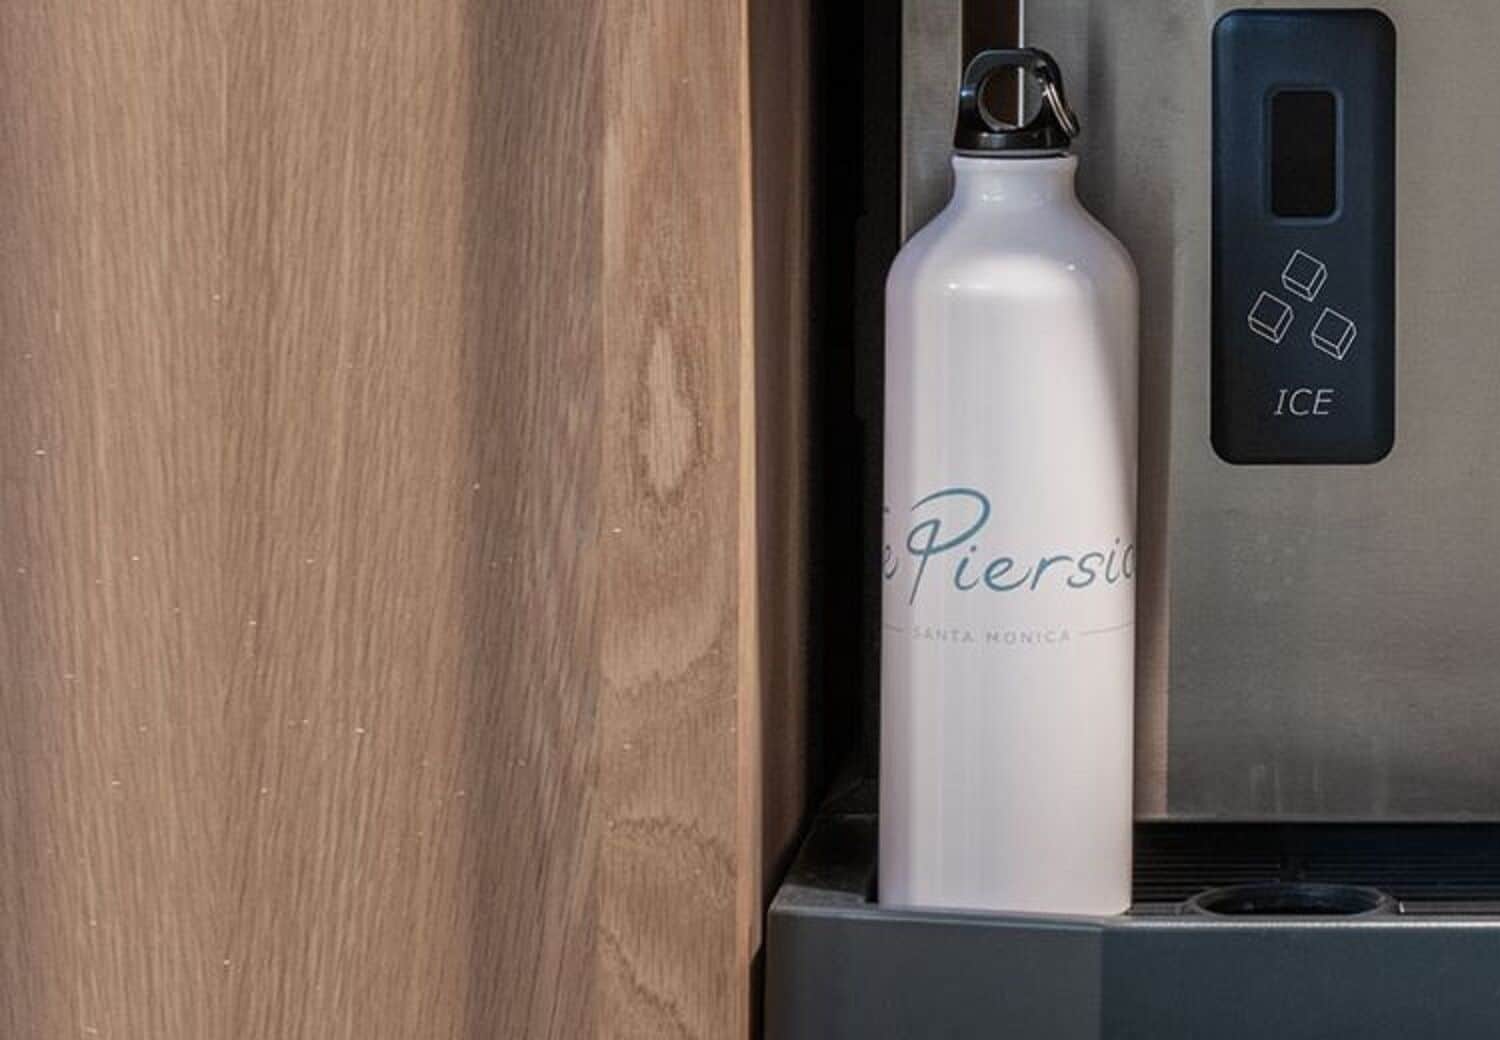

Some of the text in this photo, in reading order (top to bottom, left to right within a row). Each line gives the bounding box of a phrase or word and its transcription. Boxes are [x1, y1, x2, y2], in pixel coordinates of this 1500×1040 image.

[1273, 387, 1335, 416] ICE
[911, 624, 1071, 646] SANTA MONICA
